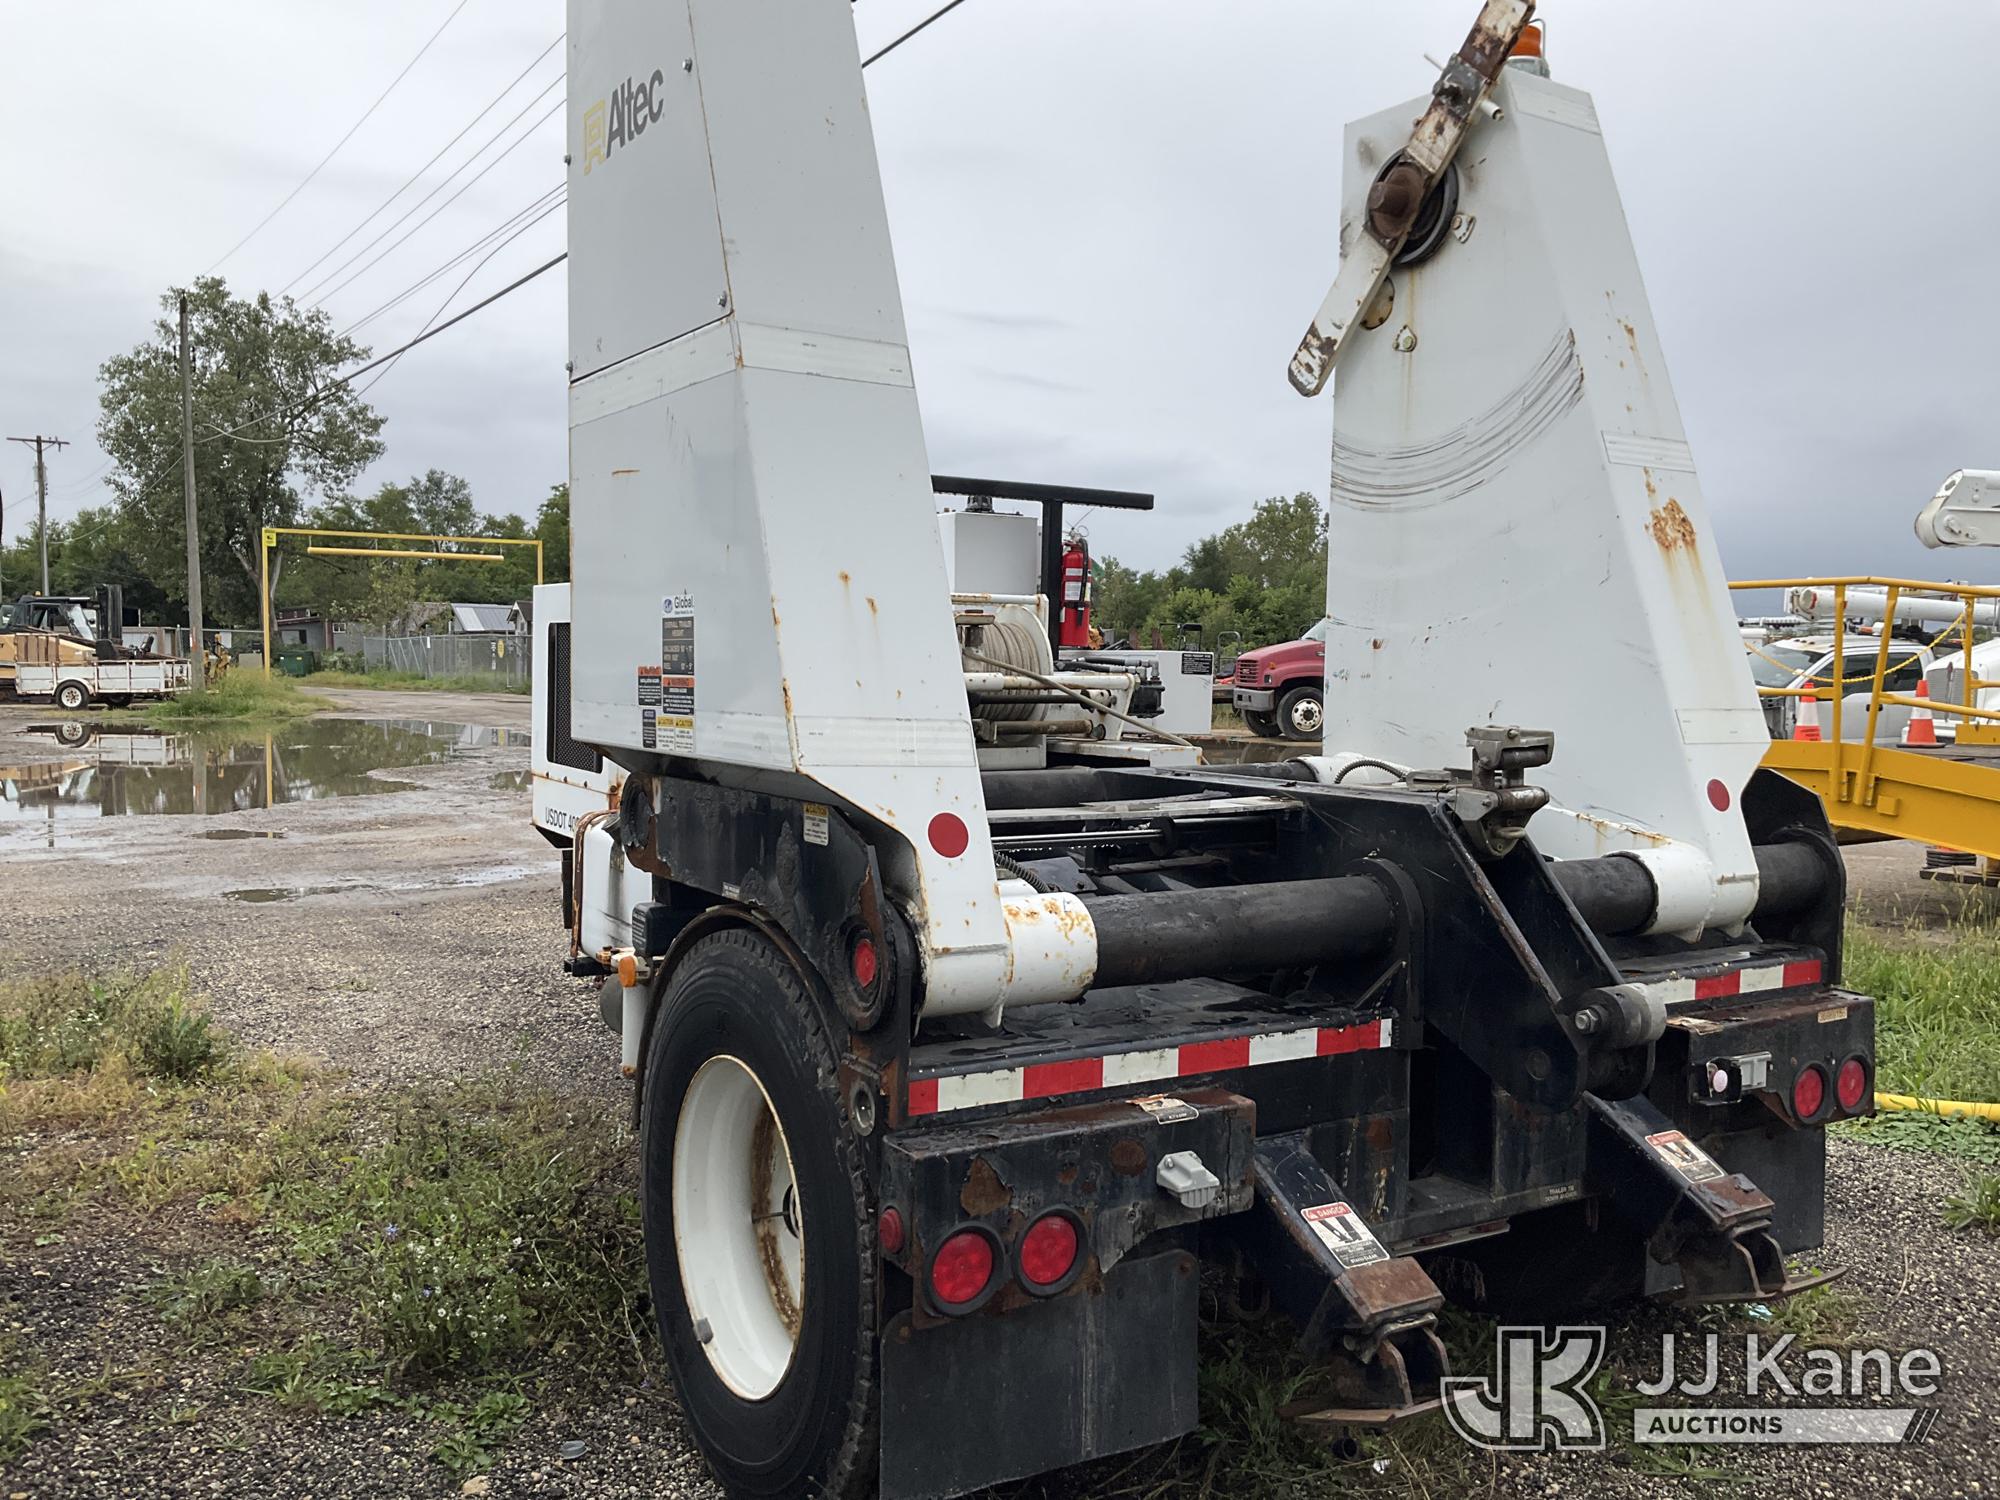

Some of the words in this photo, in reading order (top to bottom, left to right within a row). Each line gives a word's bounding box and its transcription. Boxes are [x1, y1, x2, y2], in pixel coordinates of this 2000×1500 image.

[606, 69, 664, 160] Altec
[674, 595, 694, 609] Global
[545, 807, 567, 829] USDOT
[1316, 1205, 1346, 1217] DANGER
